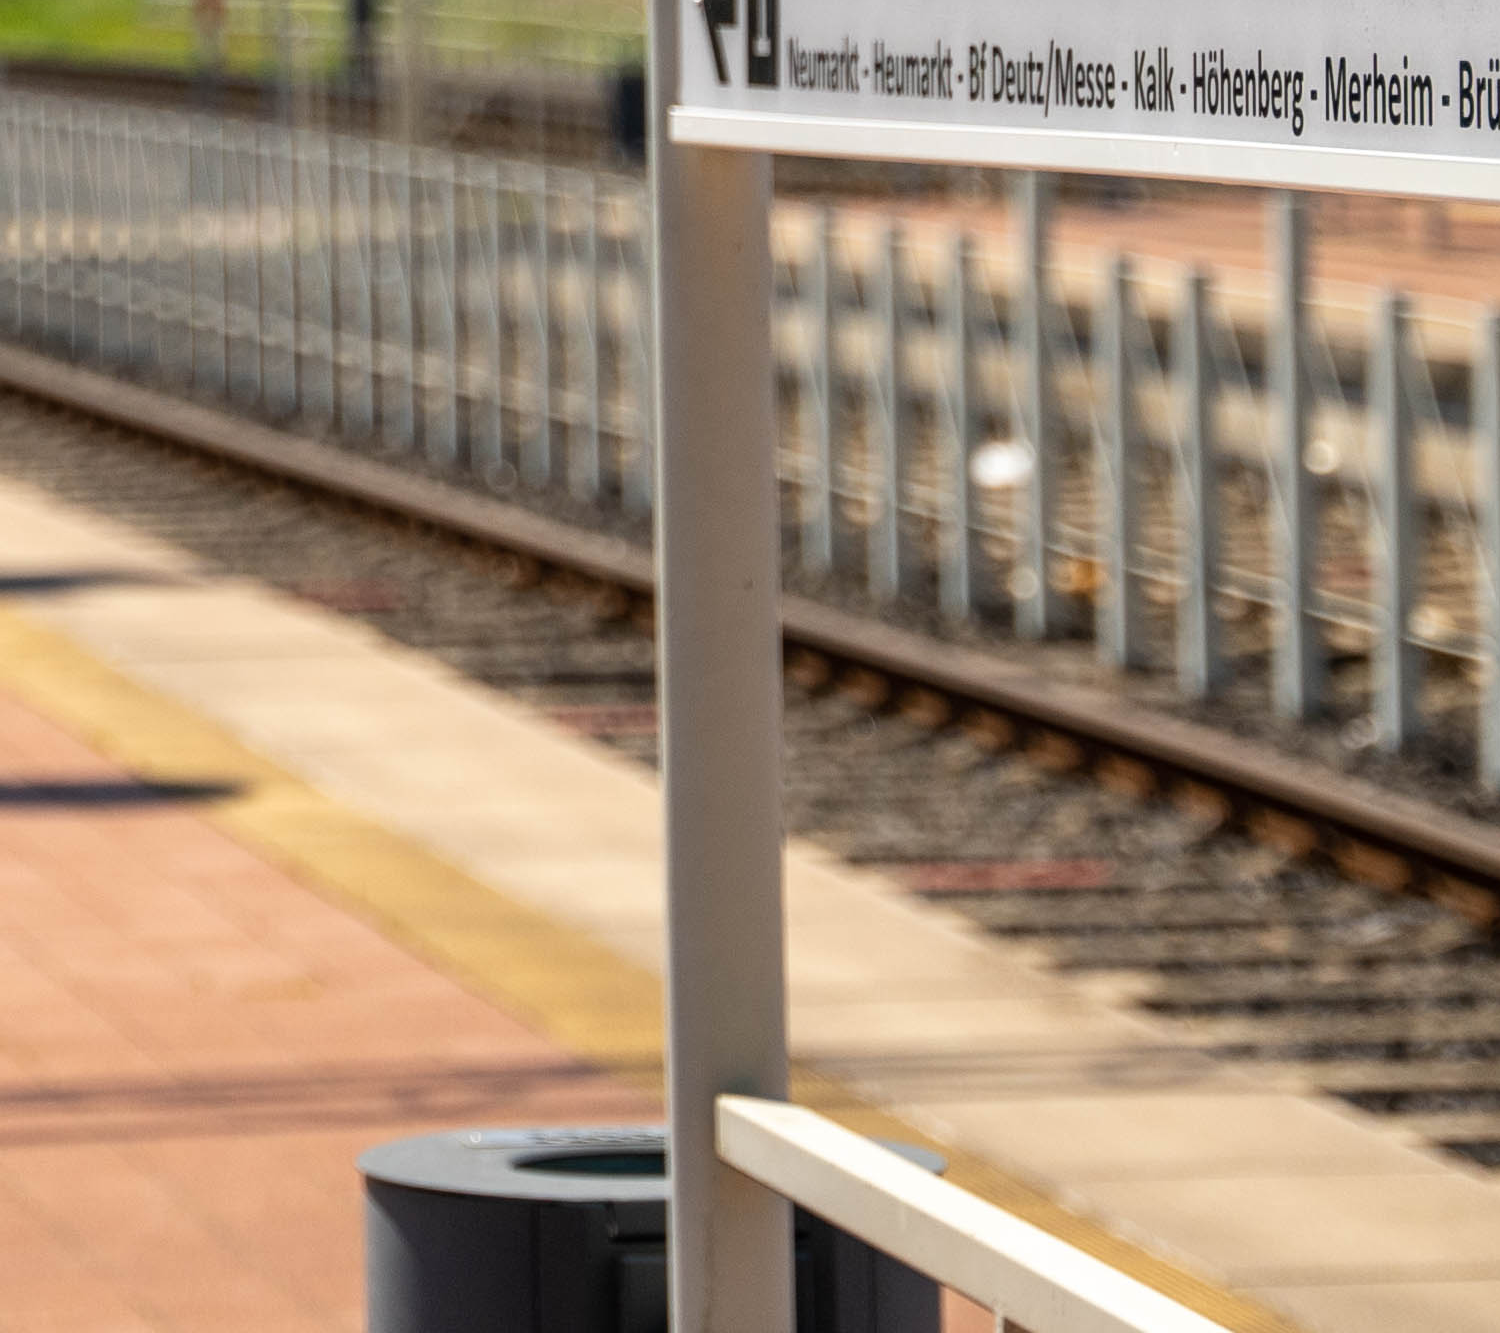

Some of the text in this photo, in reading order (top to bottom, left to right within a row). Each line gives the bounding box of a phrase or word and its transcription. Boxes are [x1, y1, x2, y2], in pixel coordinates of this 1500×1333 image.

[786, 36, 859, 92] Neumarkt
[874, 38, 953, 100] Heumarkt
[968, 40, 988, 102] Bf
[991, 39, 1116, 117] Deutz/Messe
[1133, 46, 1176, 113] Kalk
[1191, 47, 1305, 137] Höhenberg
[1324, 51, 1434, 127] Merheim
